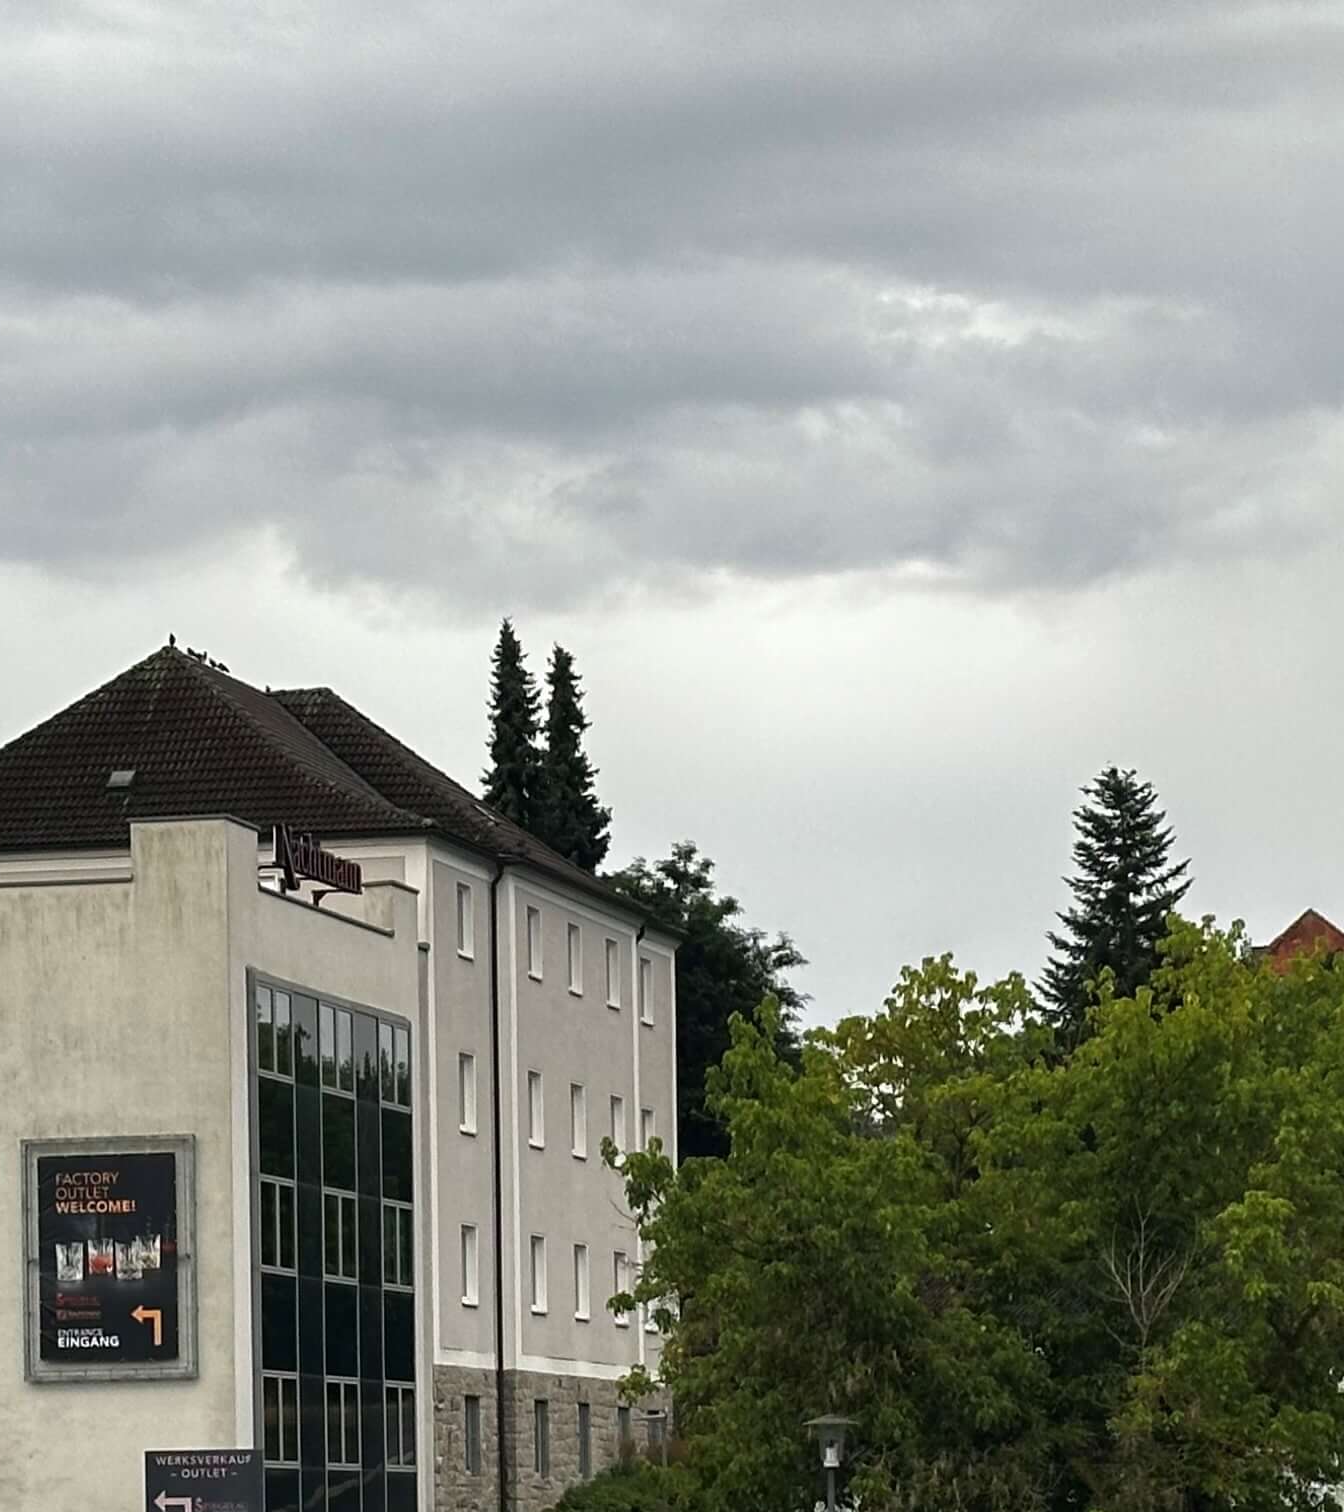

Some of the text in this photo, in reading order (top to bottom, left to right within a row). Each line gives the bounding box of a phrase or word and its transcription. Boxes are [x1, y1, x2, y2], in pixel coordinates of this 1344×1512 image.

[56, 1172, 120, 1186] FACTORY
[56, 1186, 110, 1200] OUTLET
[56, 1200, 136, 1214] WELCOME!
[58, 1336, 120, 1348] EINGANG
[156, 1455, 252, 1466] WERKSVERKAUF
[181, 1468, 227, 1478] OUTLET
